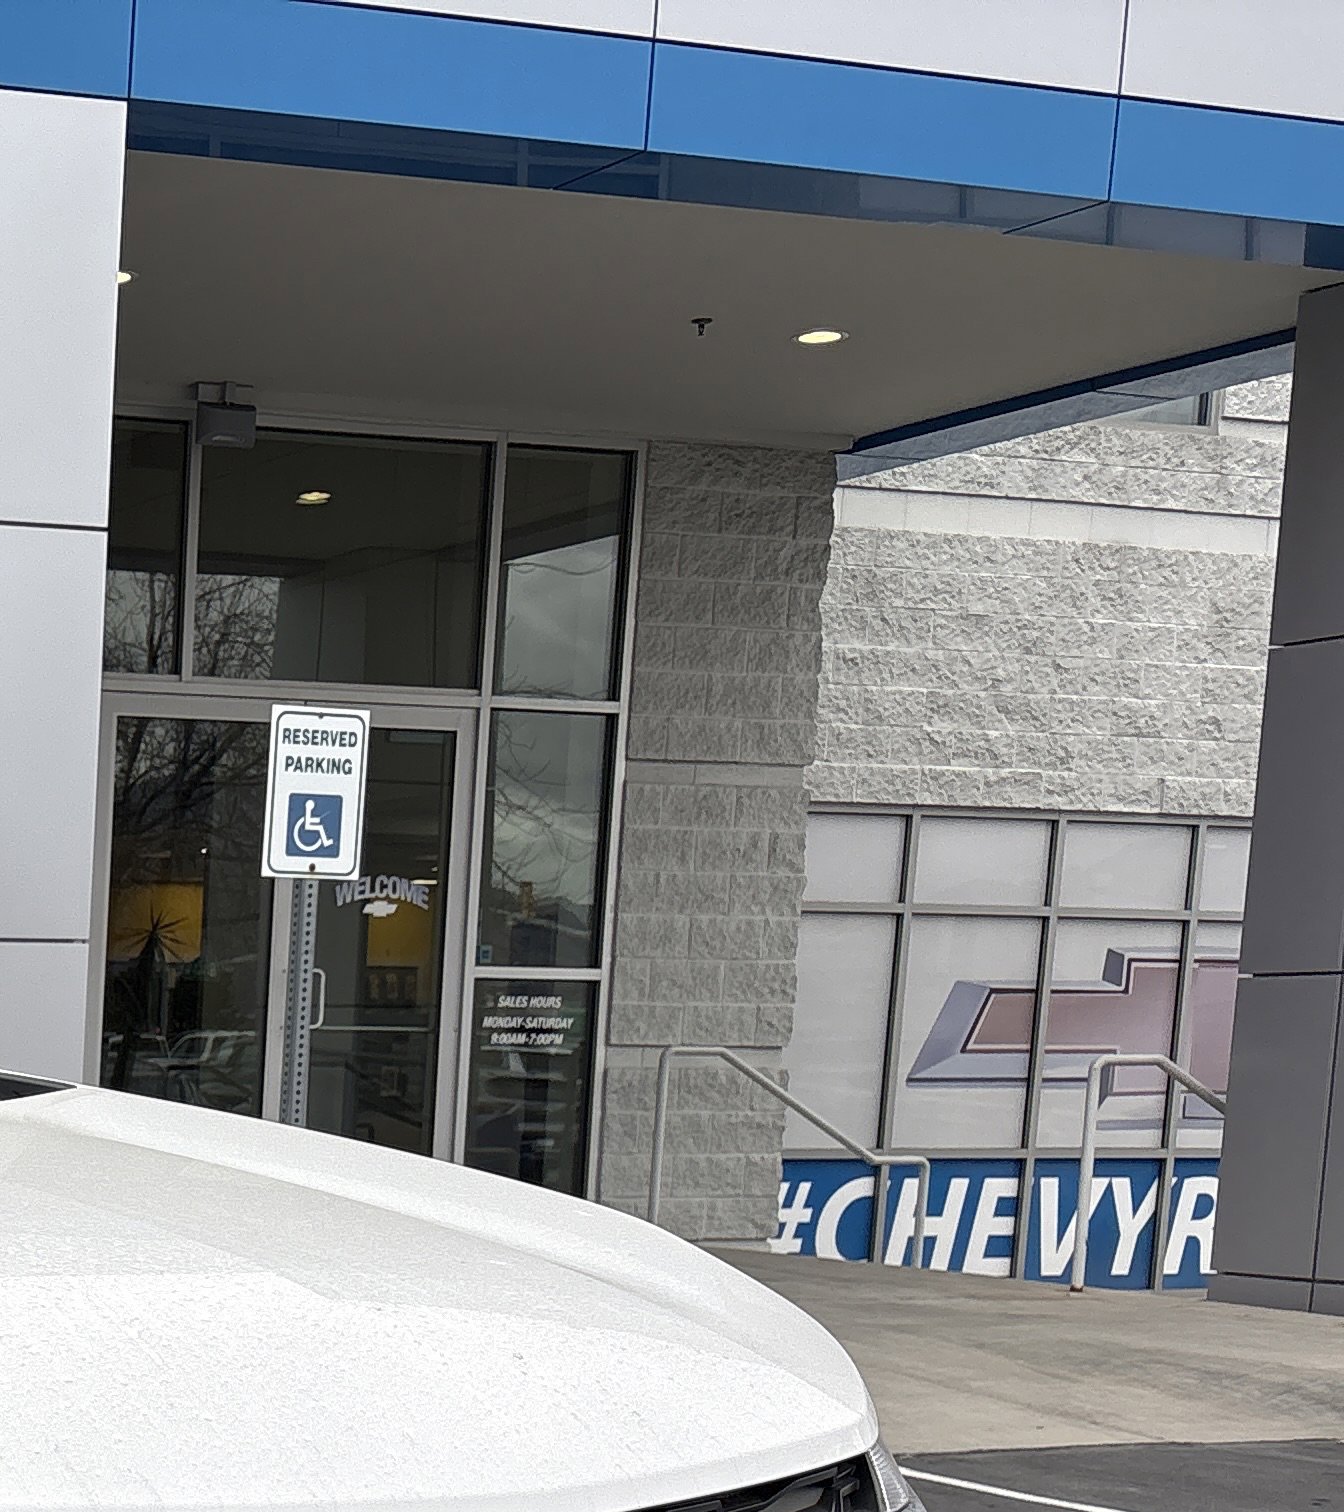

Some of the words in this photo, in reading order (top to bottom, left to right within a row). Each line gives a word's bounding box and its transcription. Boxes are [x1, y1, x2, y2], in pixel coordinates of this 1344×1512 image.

[282, 727, 358, 748] RESERVED
[284, 755, 353, 775] PARKING
[335, 874, 429, 911] WELCOME
[498, 996, 528, 1009] SALES
[529, 996, 562, 1009] HOURS
[482, 1016, 574, 1030] MONDAY-SATURDAY
